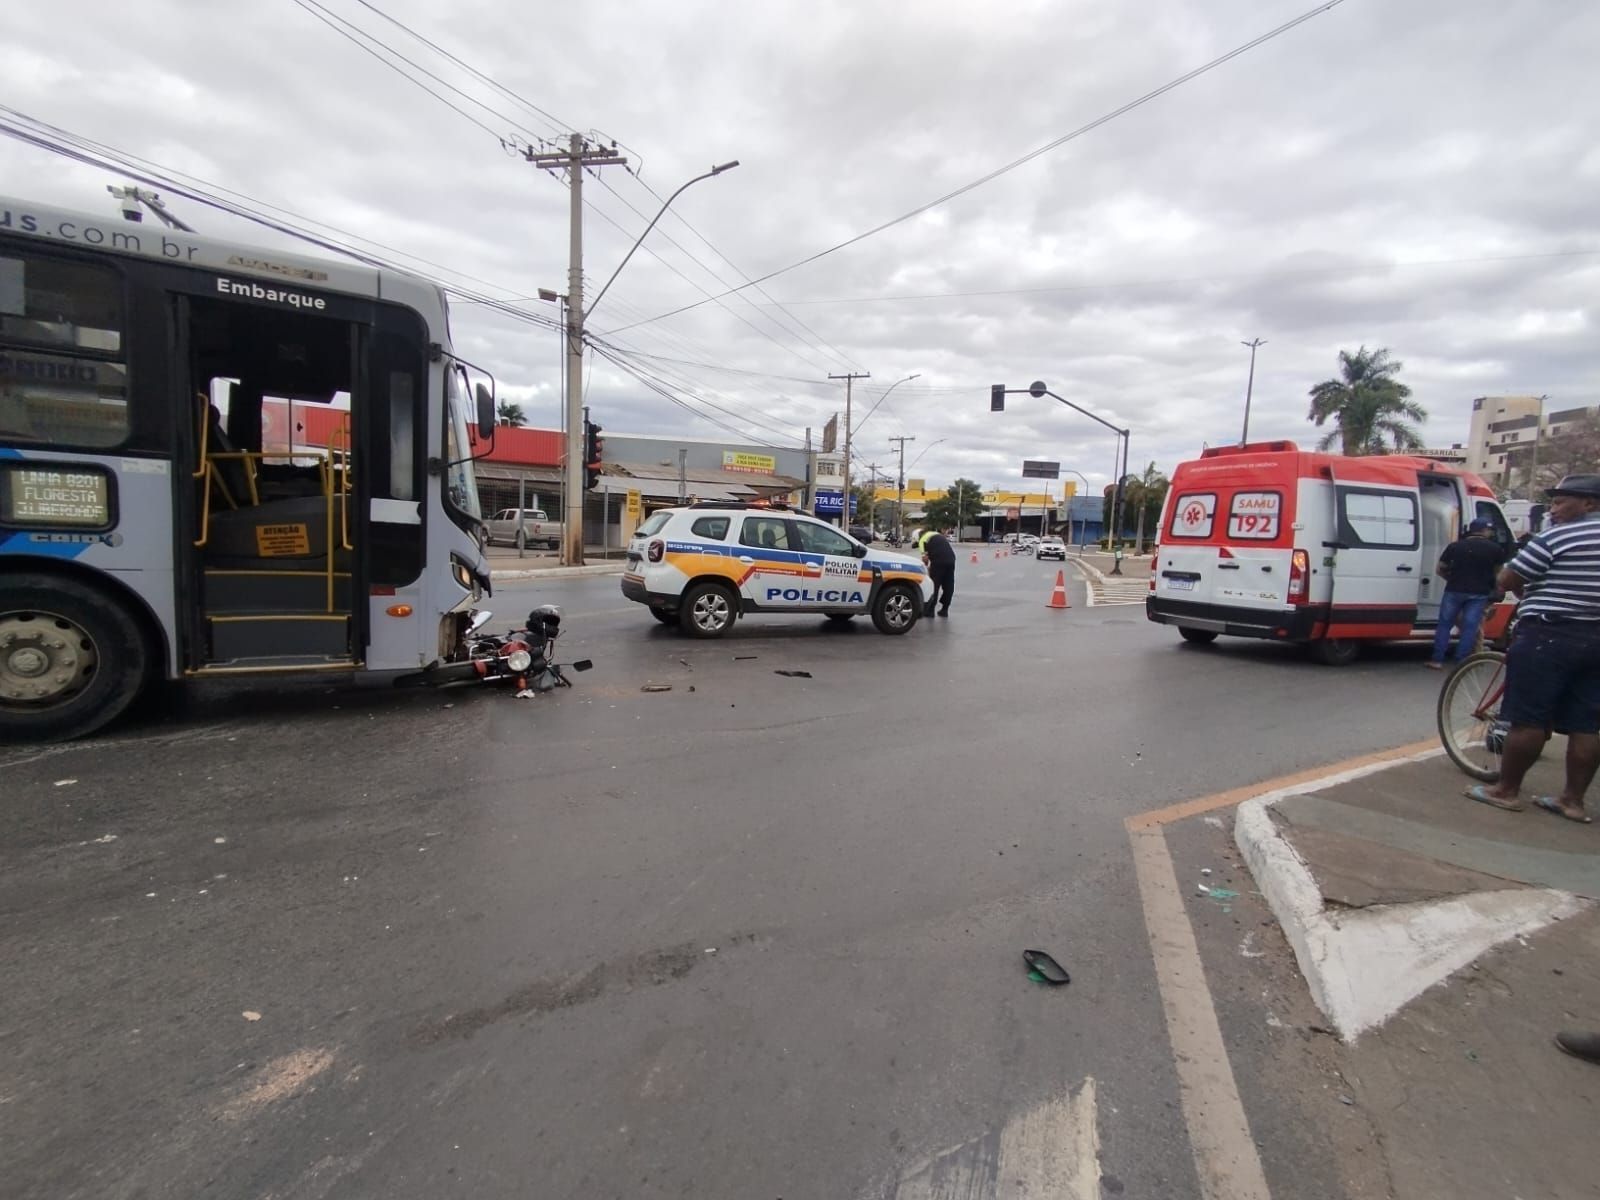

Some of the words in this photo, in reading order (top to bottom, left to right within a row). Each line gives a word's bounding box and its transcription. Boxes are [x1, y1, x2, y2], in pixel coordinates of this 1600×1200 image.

[162, 236, 198, 261] br
[217, 277, 326, 309] Embarque
[24, 487, 97, 503] FLORESTA
[829, 497, 844, 505] RIC
[1238, 498, 1276, 509] SAMU
[1236, 514, 1272, 533] 192
[825, 567, 858, 576] MILITAR
